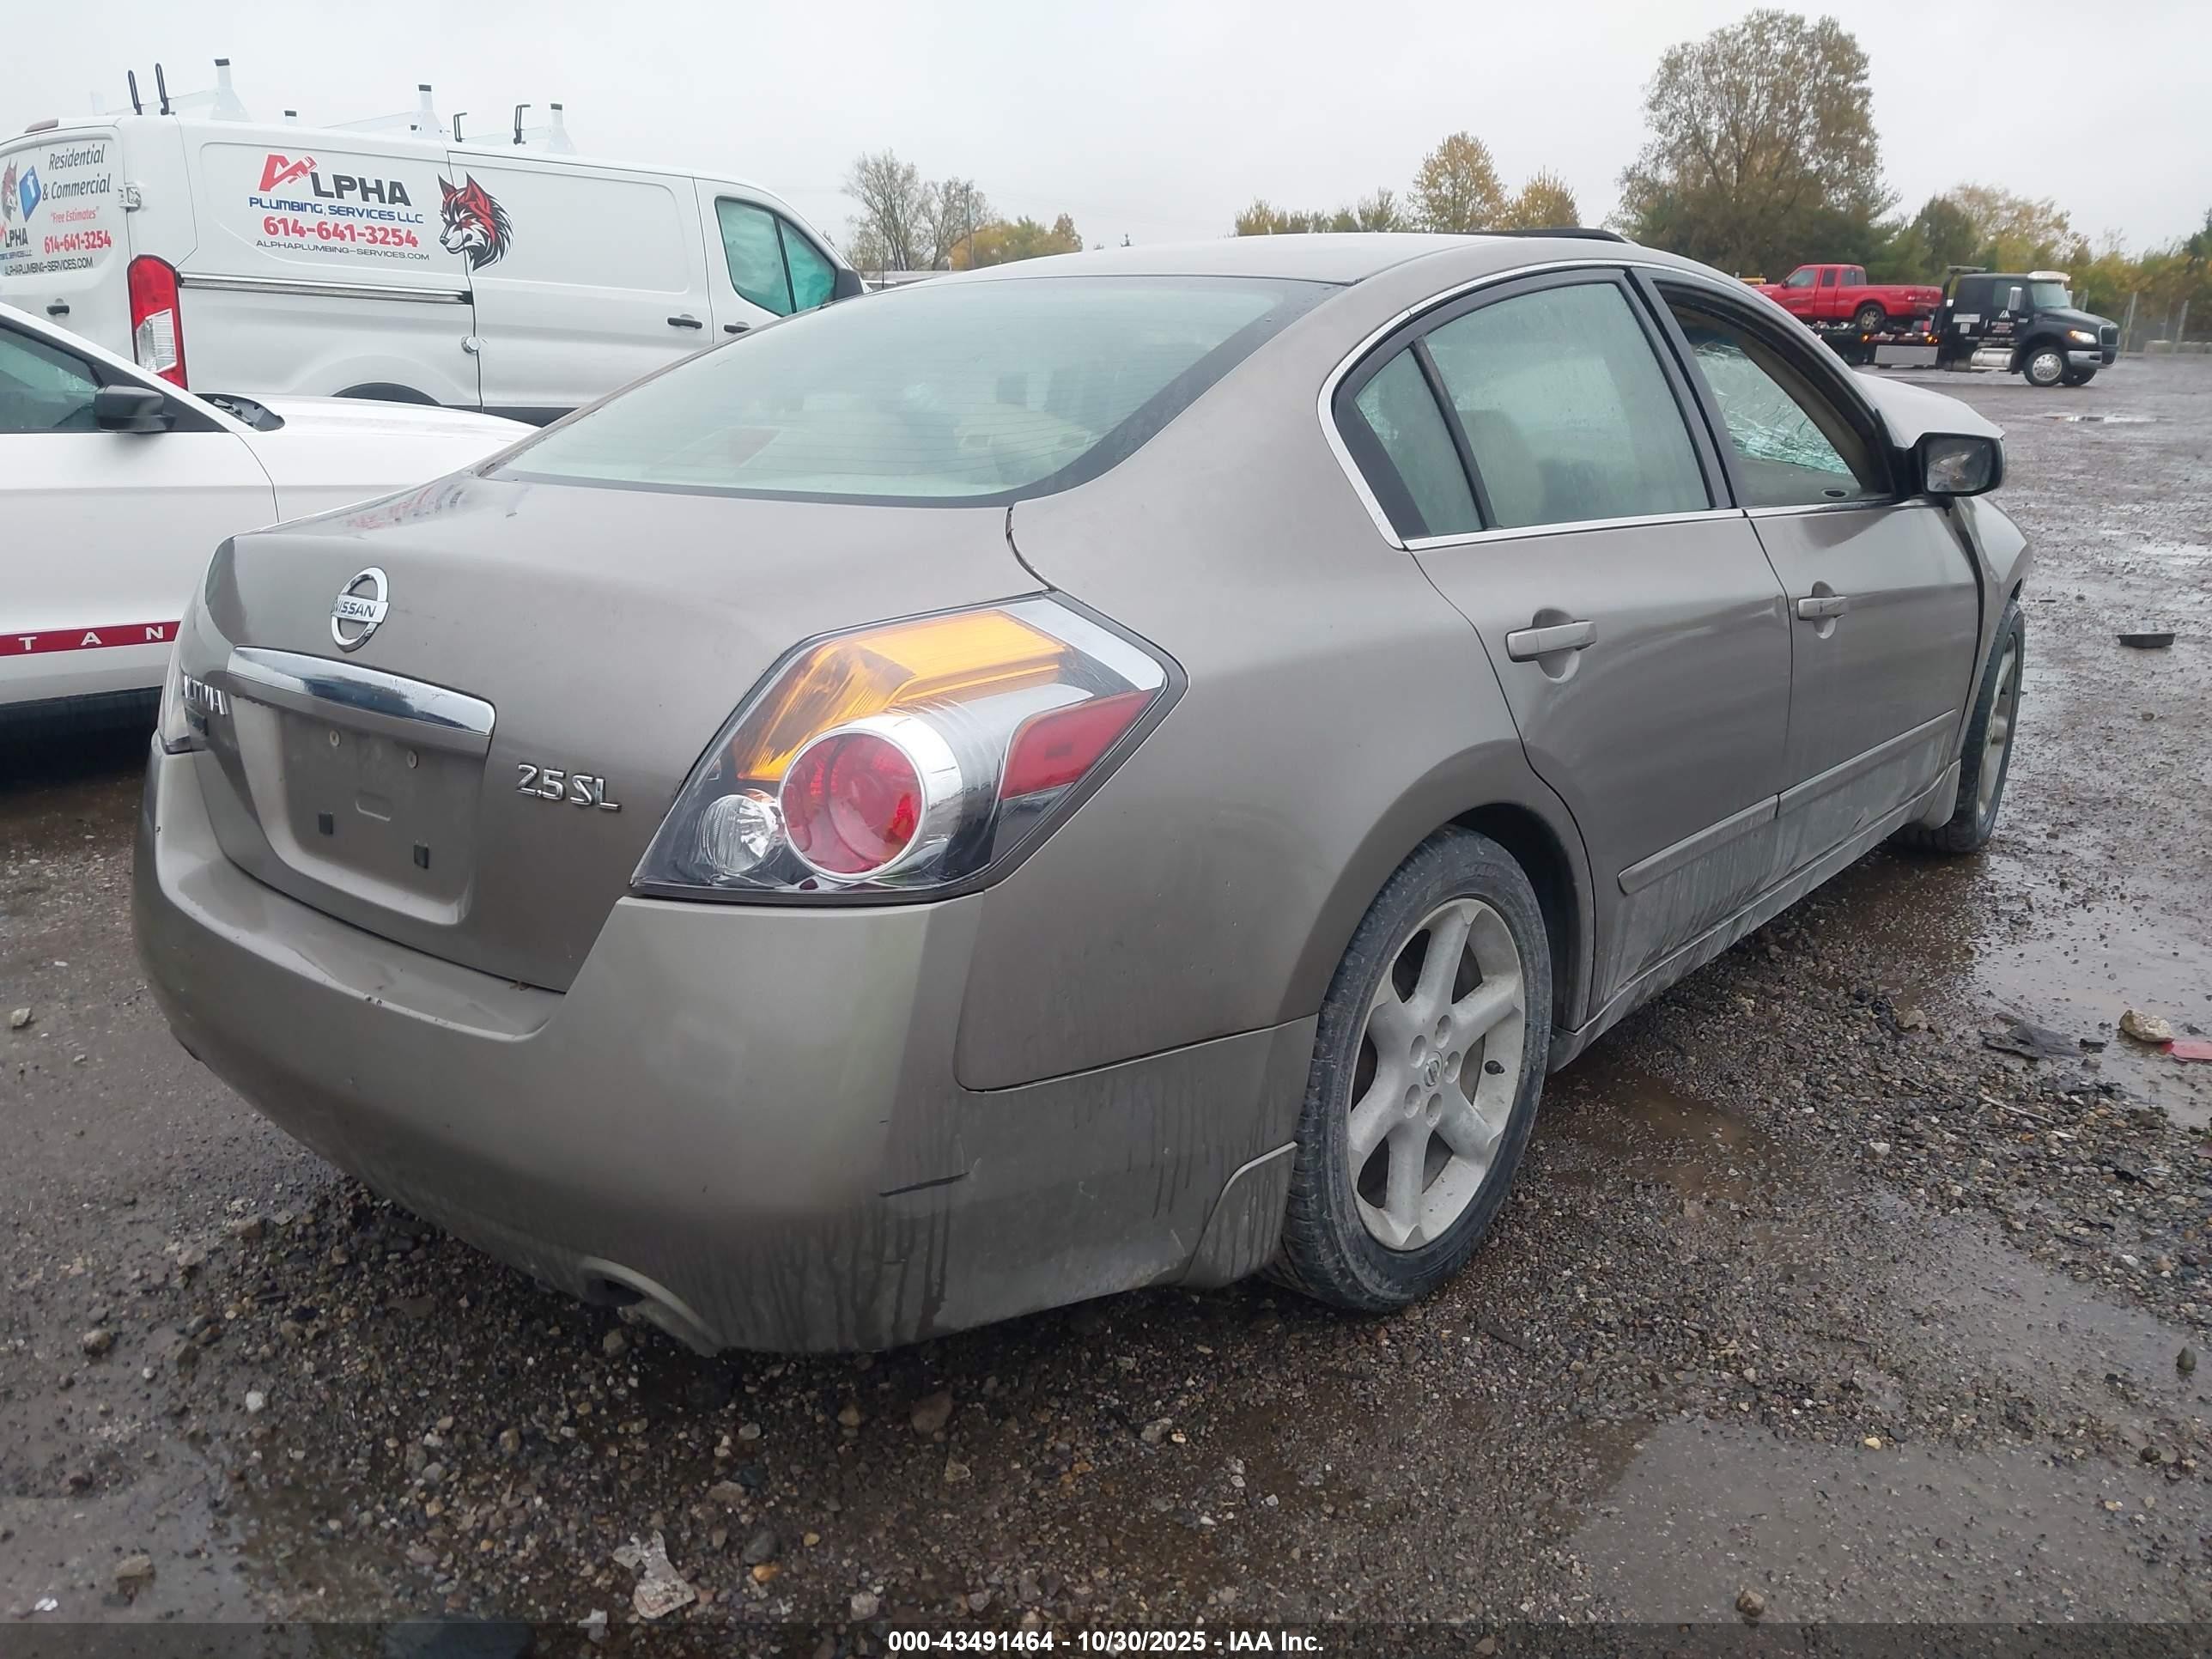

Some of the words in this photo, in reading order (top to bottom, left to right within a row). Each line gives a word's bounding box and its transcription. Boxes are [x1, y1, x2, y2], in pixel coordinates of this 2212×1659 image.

[48, 143, 106, 171] Residential
[42, 183, 49, 201] &
[51, 173, 111, 200] Commercial
[259, 154, 412, 207] ALPHA
[328, 204, 396, 222] SERVICES
[397, 211, 424, 224] LLC
[44, 229, 112, 255] 614-641-3254
[263, 215, 419, 248] 614-641-3254
[255, 239, 430, 261] ALPHAPLUMBING-SERVICES.COM
[335, 599, 377, 618] NISSAN
[569, 775, 621, 811] SL
